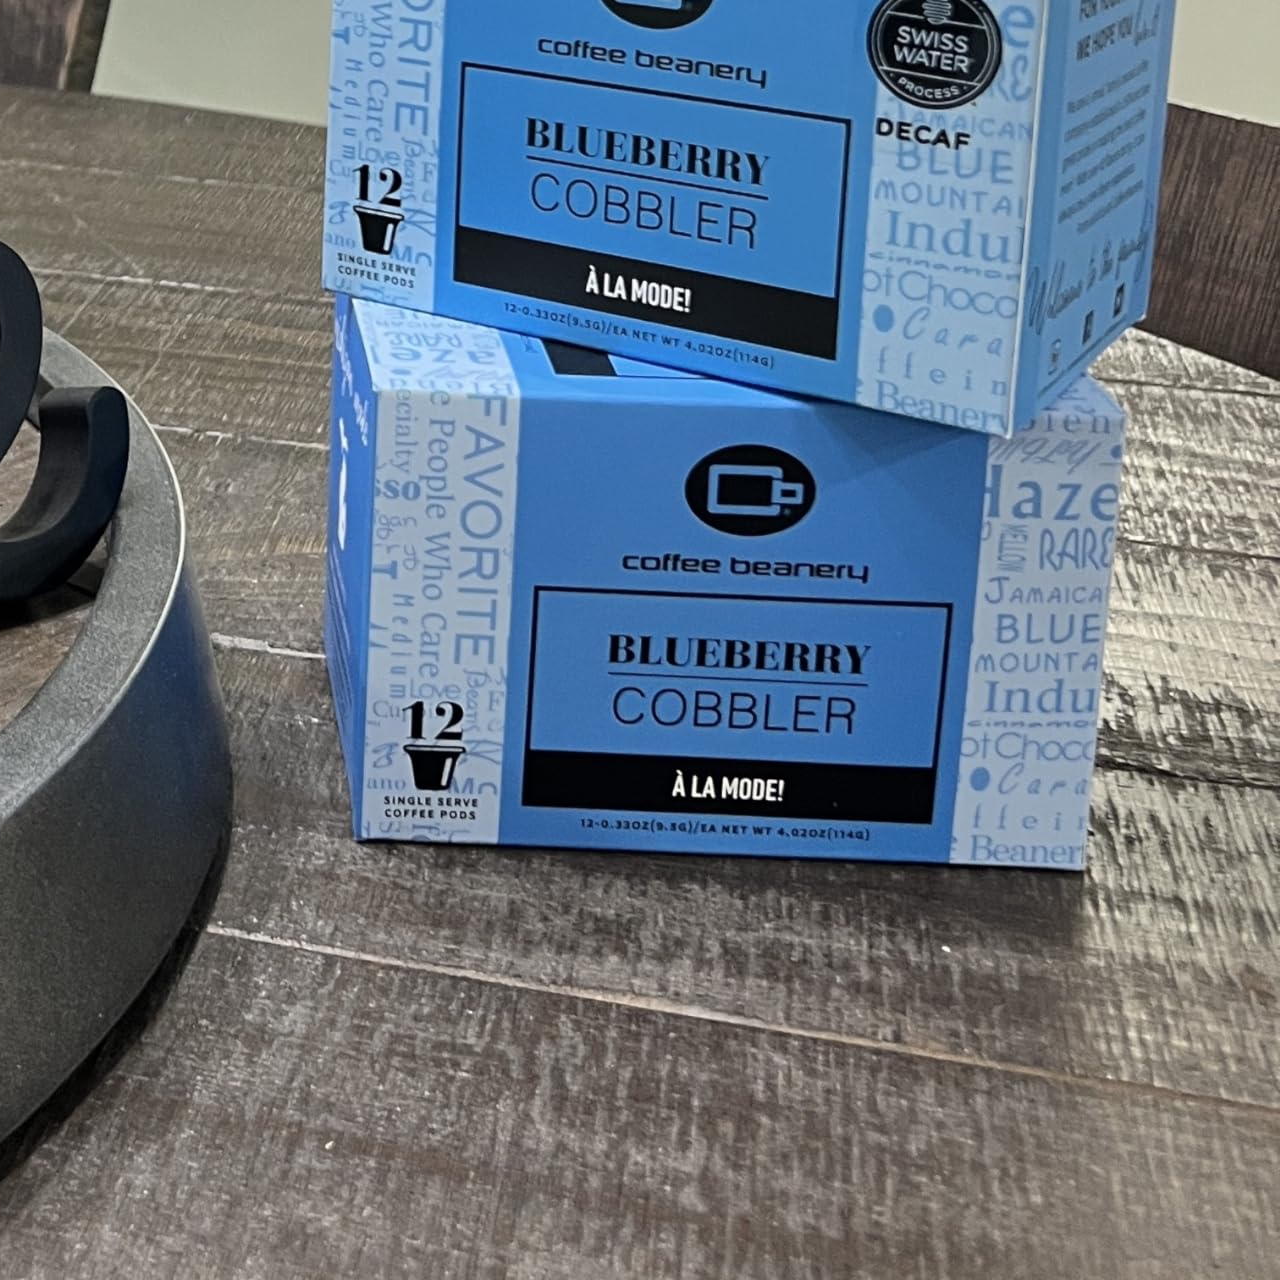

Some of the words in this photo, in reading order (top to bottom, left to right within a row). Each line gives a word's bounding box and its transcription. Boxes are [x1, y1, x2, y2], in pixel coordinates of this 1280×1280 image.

[368, 2, 394, 68] Who
[896, 25, 969, 54] SWISS
[537, 37, 627, 65] coffee
[634, 48, 767, 89] beanery
[893, 45, 970, 73] WATER
[897, 76, 961, 99] PROCESS
[365, 80, 390, 142] Care
[526, 117, 771, 186] BLUEBERRY
[875, 117, 971, 151] DECAF
[895, 142, 1014, 185] BLUE
[353, 164, 402, 207] 12
[531, 172, 758, 250] COBBLER
[337, 252, 377, 269] SINGLE
[381, 261, 417, 277] SERVE
[337, 265, 379, 282] COFFEE
[384, 274, 415, 289] PODS
[585, 265, 602, 293] À
[603, 272, 628, 299] LA
[629, 276, 692, 313] MODE!
[632, 329, 657, 343] NET
[661, 334, 680, 348] WT
[419, 419, 457, 519] People
[453, 393, 508, 665] FAVORITE
[421, 531, 451, 601] Who
[622, 553, 721, 574] coffee
[730, 556, 869, 584] beanery
[389, 593, 416, 698] Medium
[418, 612, 447, 678] Care
[995, 613, 1100, 645] BLUE
[608, 633, 872, 676] BLUEBERRY
[402, 701, 465, 740] 12
[613, 686, 857, 735] COBBLER
[383, 795, 432, 807] SINGLE
[437, 797, 479, 808] SERVE
[672, 770, 686, 798] À
[691, 777, 716, 799] LA
[721, 777, 786, 803] MODE!
[384, 808, 435, 819] COFFEE
[440, 809, 477, 820] PODS
[721, 825, 748, 835] NET
[752, 826, 772, 836] WT
